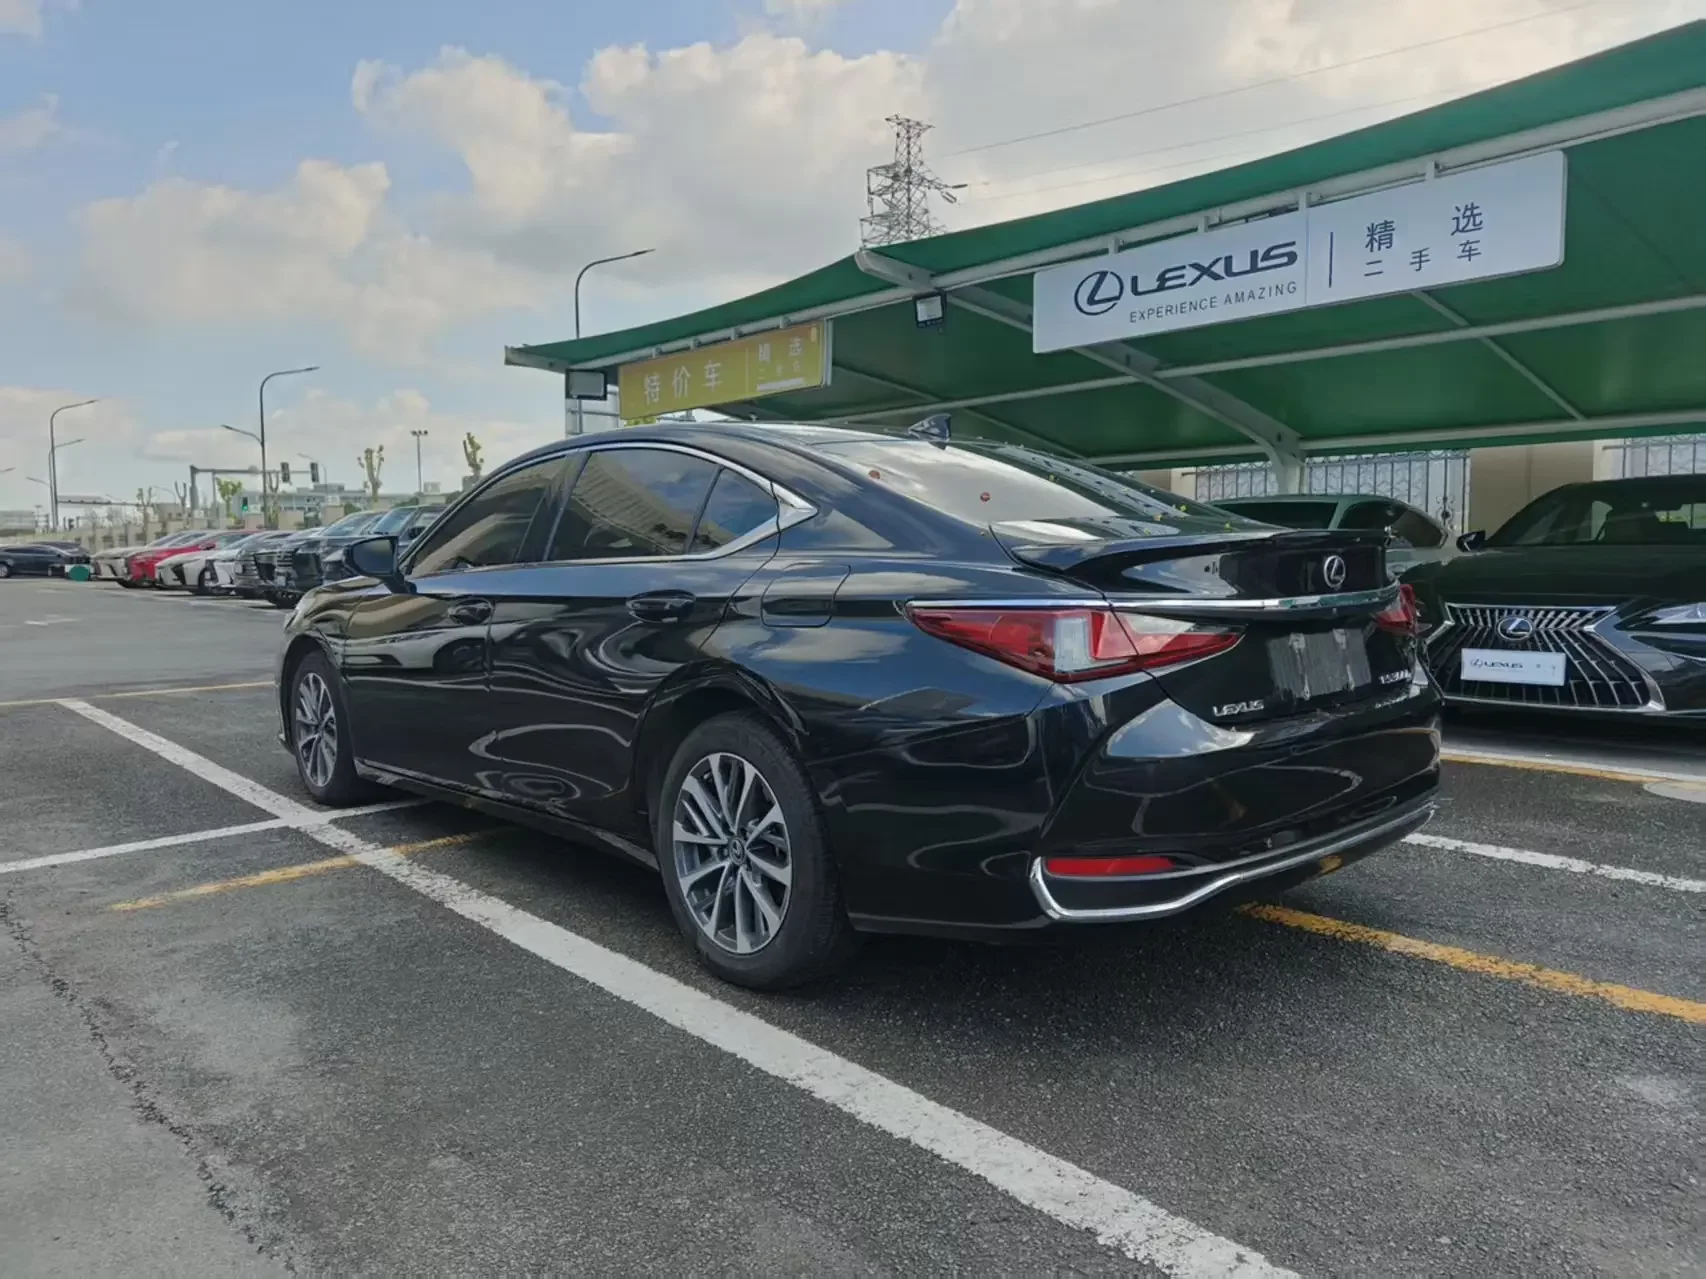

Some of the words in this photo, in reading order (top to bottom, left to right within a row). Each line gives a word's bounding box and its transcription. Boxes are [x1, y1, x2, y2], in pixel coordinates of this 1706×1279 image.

[1364, 202, 1484, 253] 精选
[1130, 240, 1298, 297] LEXUS
[1364, 239, 1483, 278] 二手车
[1129, 296, 1218, 323] EXPERIENCE
[1223, 281, 1298, 305] AMAZING
[643, 360, 723, 406] 特价车
[1211, 698, 1265, 717] LEXUS
